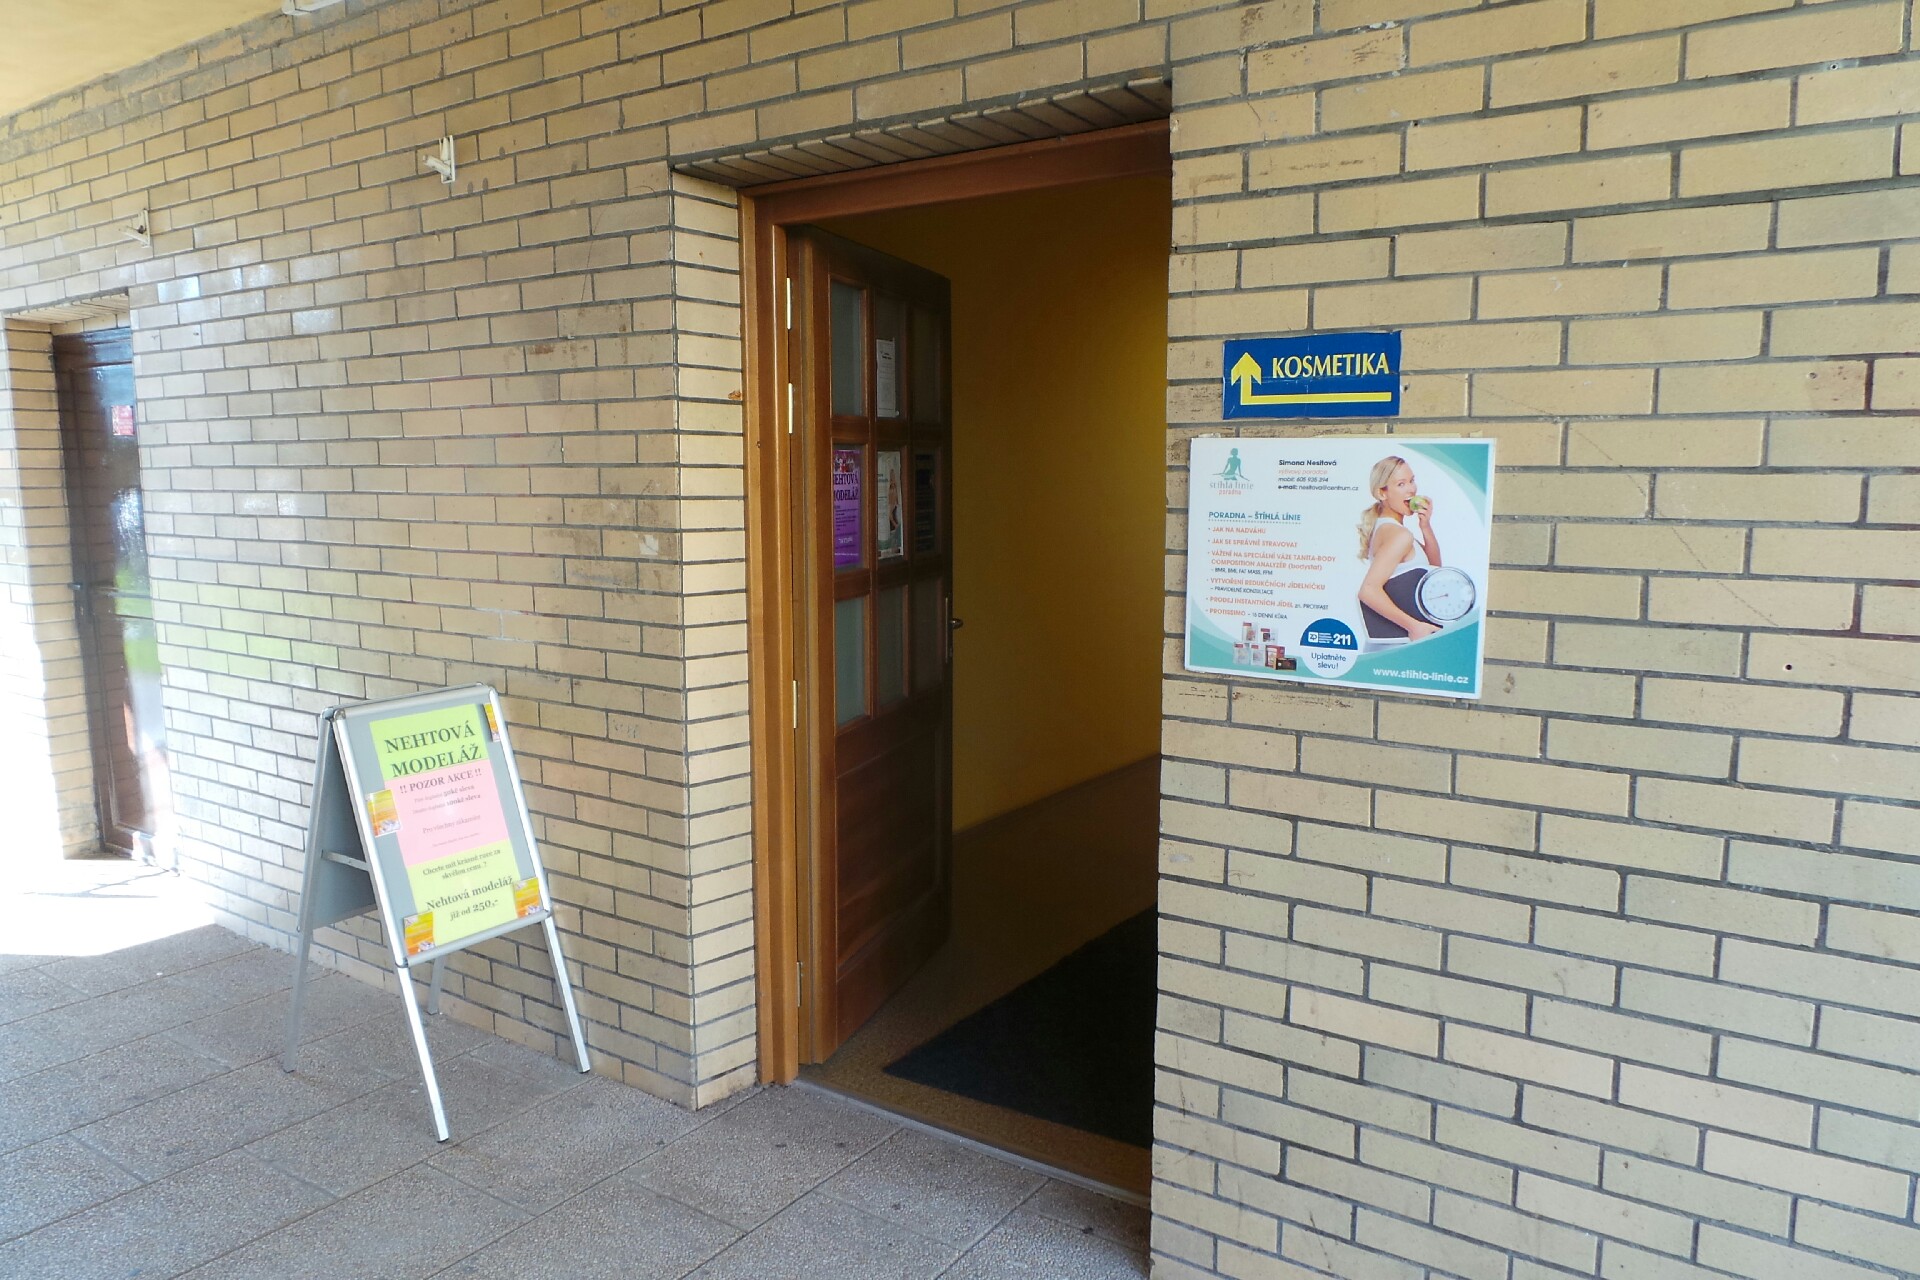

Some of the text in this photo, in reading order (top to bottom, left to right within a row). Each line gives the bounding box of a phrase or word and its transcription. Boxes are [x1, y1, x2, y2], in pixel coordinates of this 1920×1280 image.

[1272, 352, 1390, 379] KOSMETIKA
[1208, 511, 1246, 519] PORADNA
[1254, 511, 1280, 521] ŠTÍHLÁ
[1282, 512, 1301, 521] LÍNIE
[1262, 540, 1297, 548] STRAVOVAT
[1211, 558, 1255, 567] COMPOSITION
[1209, 596, 1233, 604] PRODEJ
[1332, 632, 1352, 646] 211
[1311, 651, 1347, 663] Uplatněte
[1372, 667, 1469, 684] www.stihla-linie.cz
[384, 719, 476, 754] NEHTOVÁ
[391, 743, 482, 778] MODELÁŽ
[409, 776, 445, 792] POZOR
[446, 769, 474, 784] AKCE
[422, 865, 445, 876] Chcete
[426, 876, 514, 912] Nehtová modeláž
[461, 907, 471, 917] od
